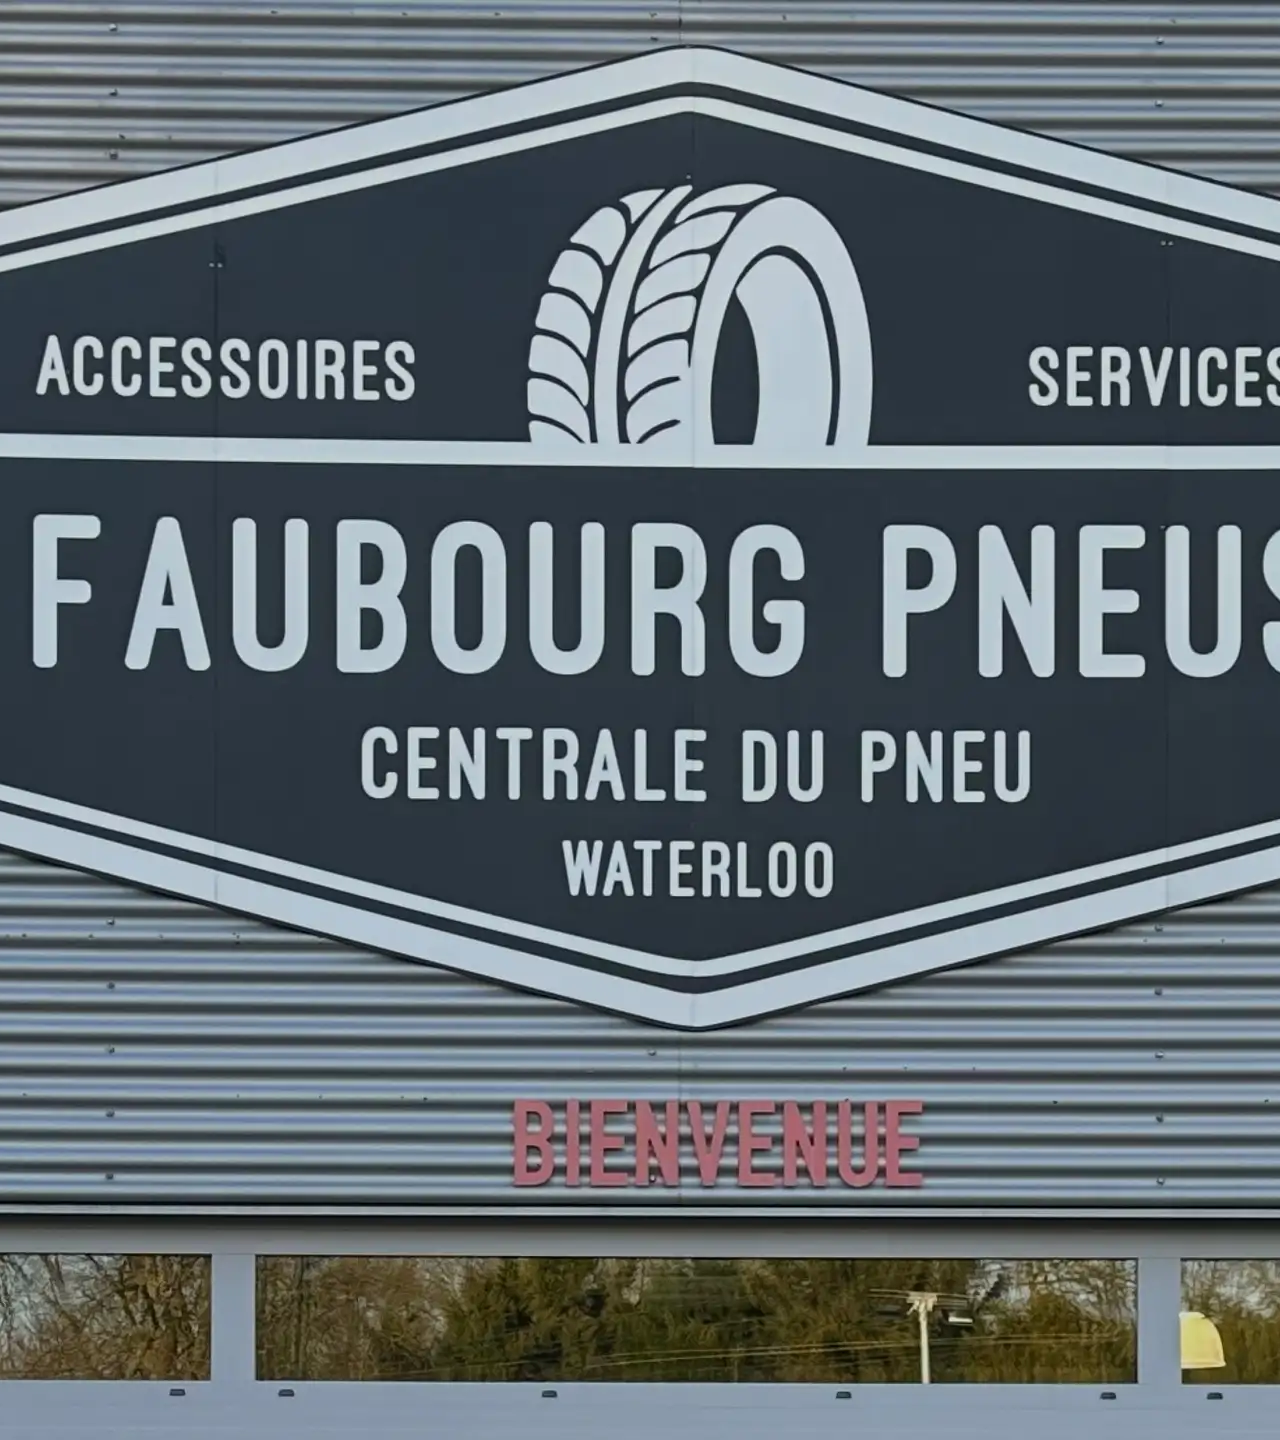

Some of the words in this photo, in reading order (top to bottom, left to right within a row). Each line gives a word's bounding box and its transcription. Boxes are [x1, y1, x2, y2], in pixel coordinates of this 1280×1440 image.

[35, 334, 417, 403] ACCESSOIRES
[31, 513, 806, 678] FAUBOURG
[360, 725, 707, 803] CENTRALE
[742, 729, 824, 803] DU
[861, 730, 1032, 804] PNEU
[562, 839, 834, 898] WATERLOO
[511, 1098, 924, 1188] BIENVENUE
